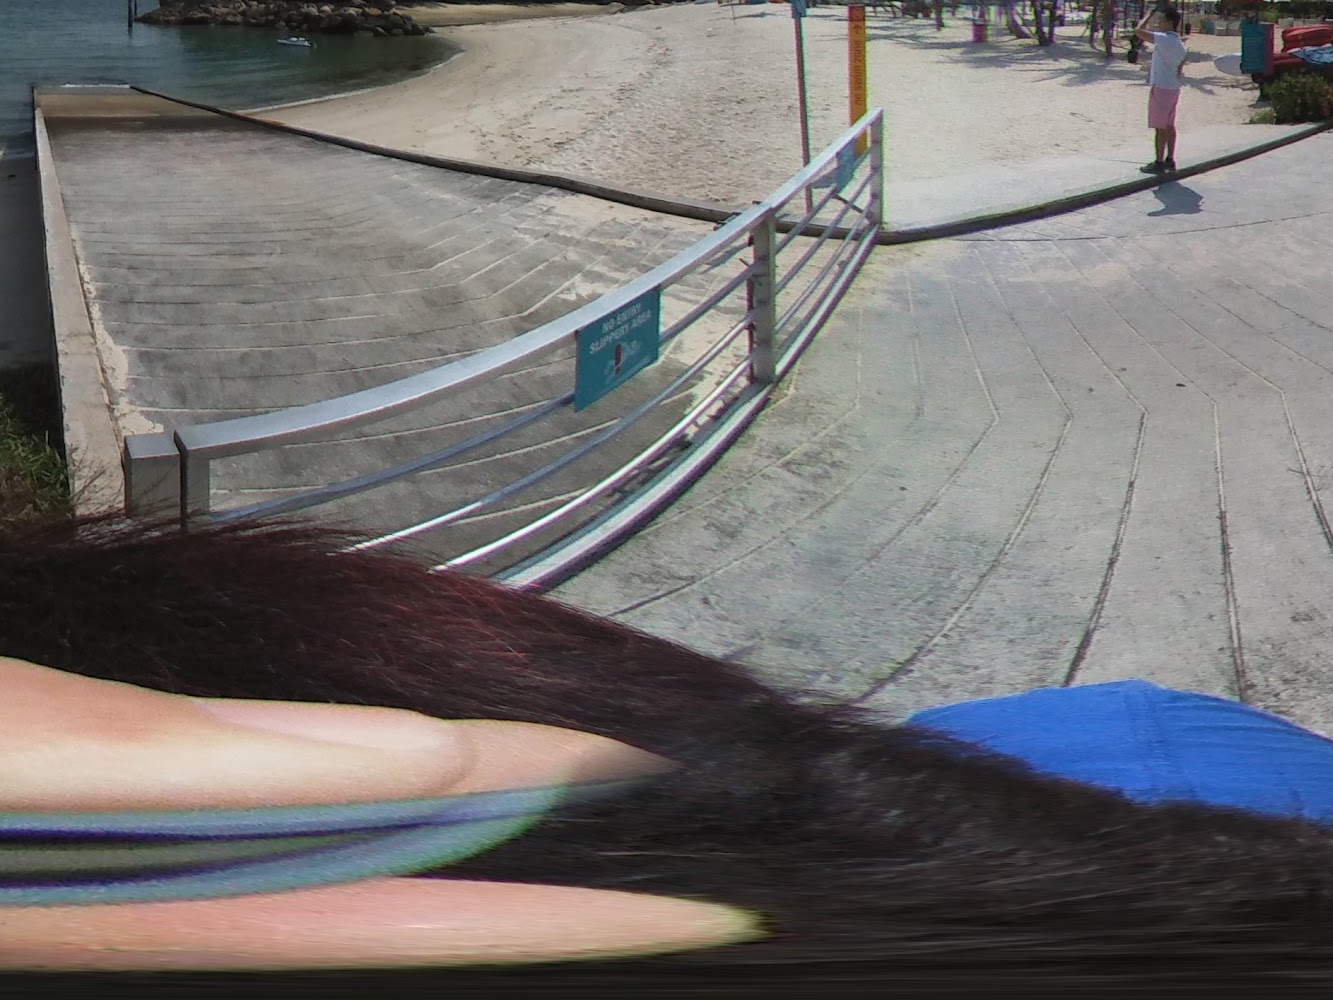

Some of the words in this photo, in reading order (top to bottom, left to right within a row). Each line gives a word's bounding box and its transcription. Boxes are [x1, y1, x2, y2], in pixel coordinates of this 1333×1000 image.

[589, 322, 629, 354] SLIPPERY
[631, 309, 651, 329] AREA
[602, 318, 615, 333] NO
[616, 302, 641, 325] ENTRY
